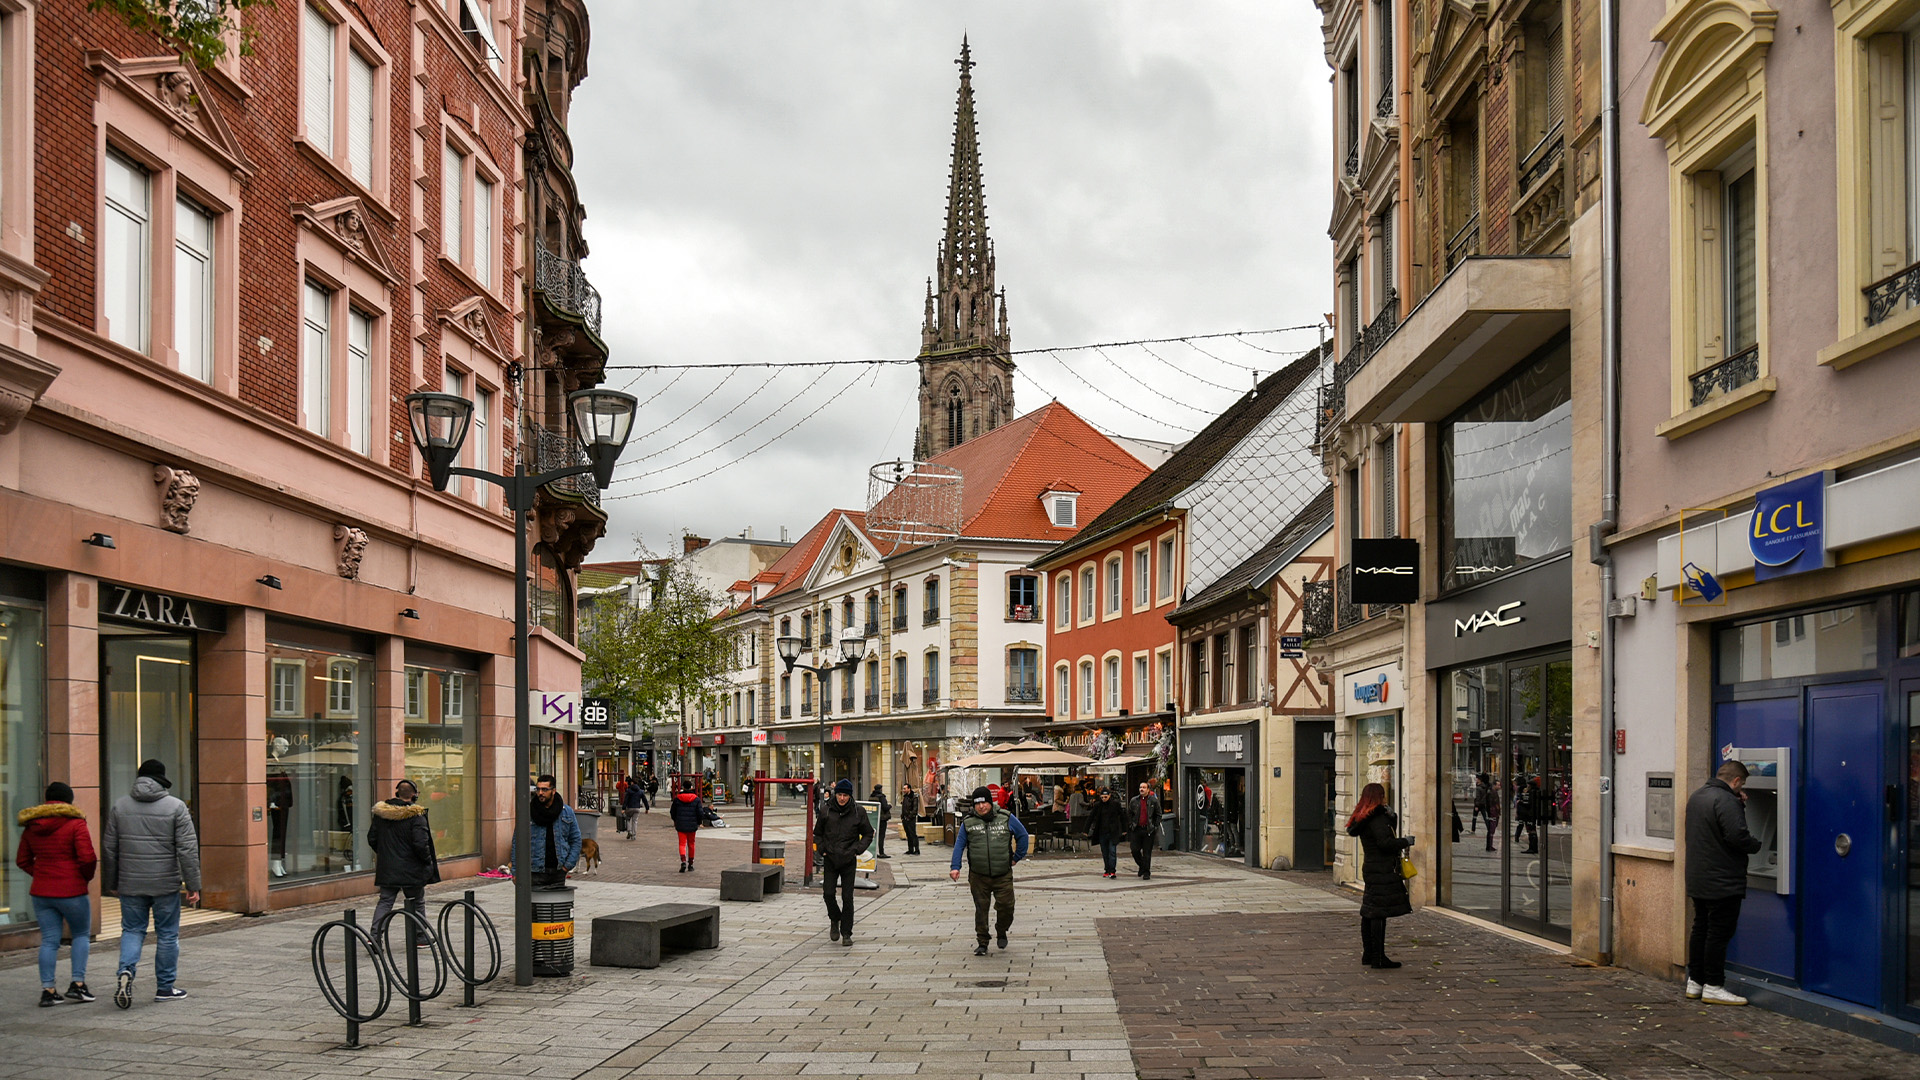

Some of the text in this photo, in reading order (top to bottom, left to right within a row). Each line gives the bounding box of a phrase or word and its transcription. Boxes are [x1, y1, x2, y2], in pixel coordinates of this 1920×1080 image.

[1754, 501, 1813, 538] LCL
[1793, 529, 1820, 540] ASSURANCE
[114, 586, 198, 628] ZARA
